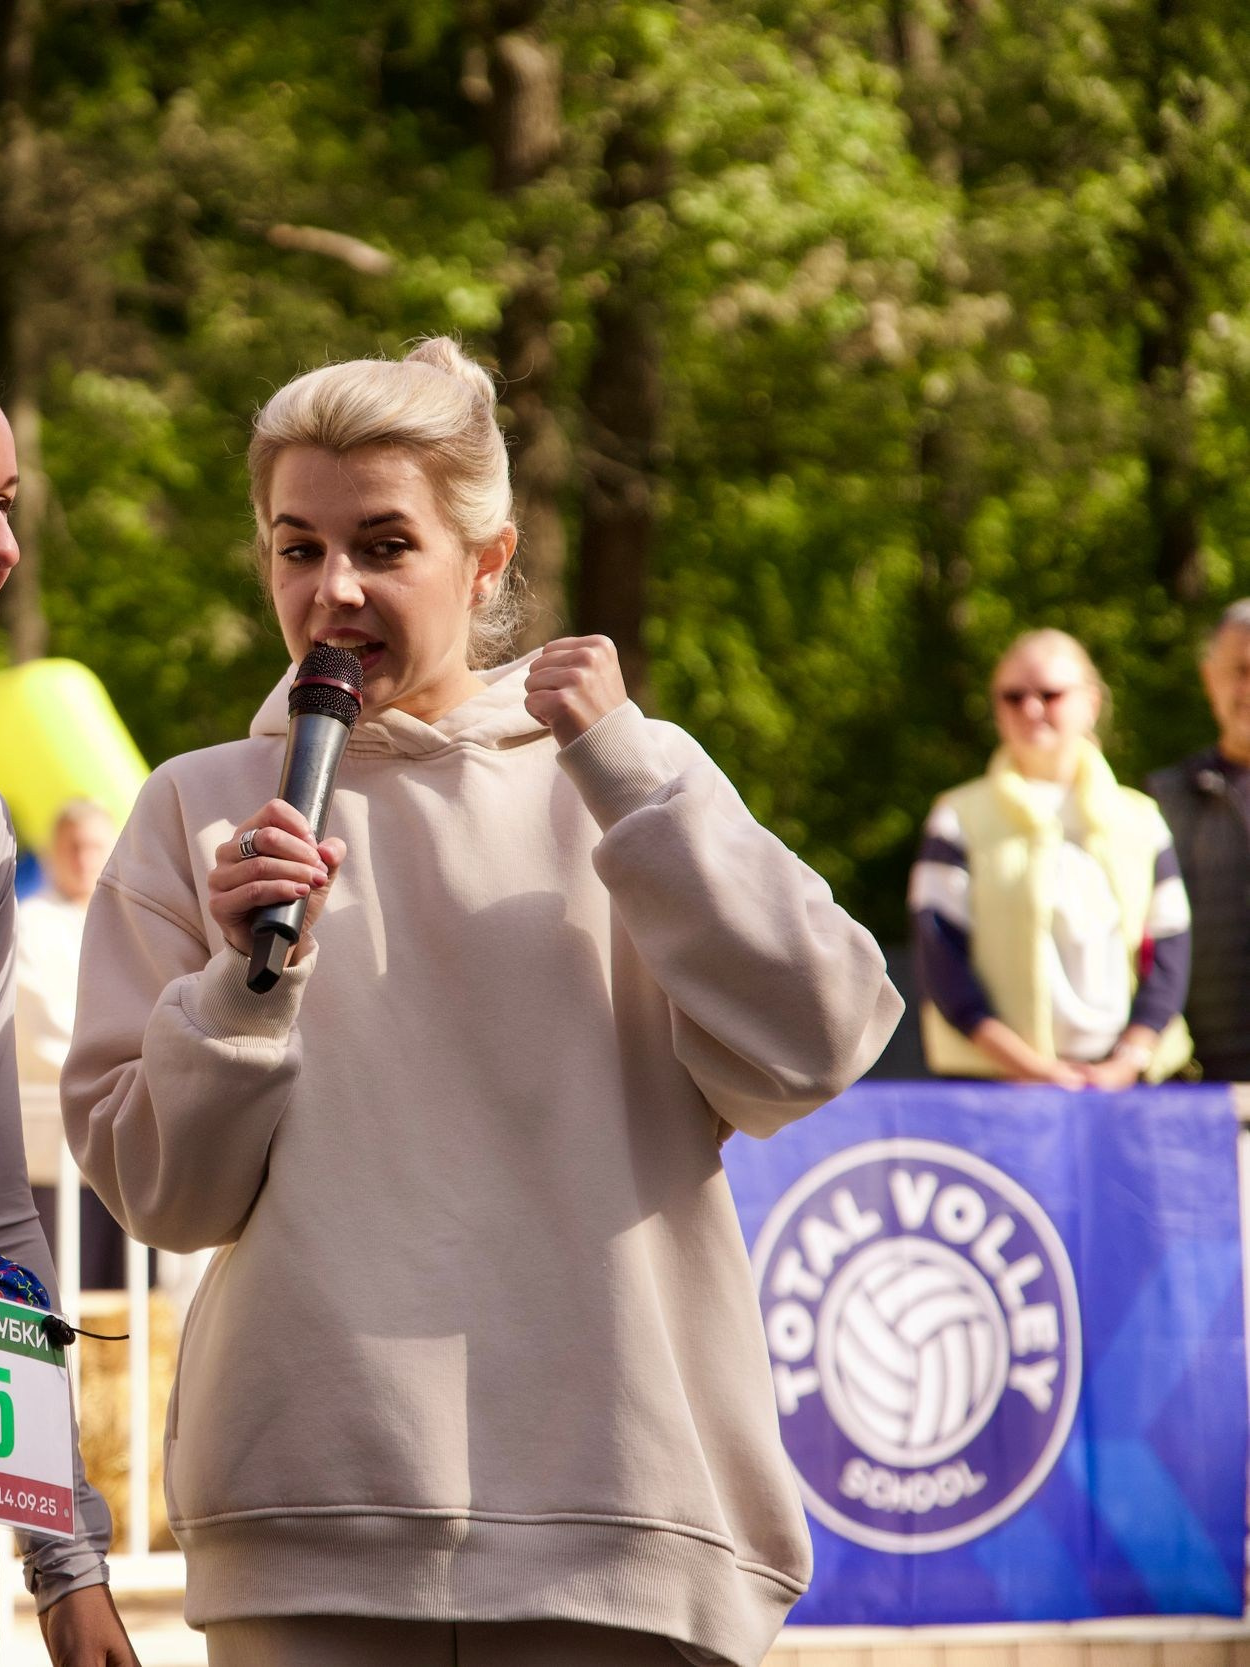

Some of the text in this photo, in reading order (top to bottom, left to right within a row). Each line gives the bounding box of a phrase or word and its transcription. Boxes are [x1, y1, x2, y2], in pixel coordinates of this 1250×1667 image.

[766, 1168, 1060, 1416] TOTAL VOLLEY
[838, 1456, 988, 1515] SCHOOL
